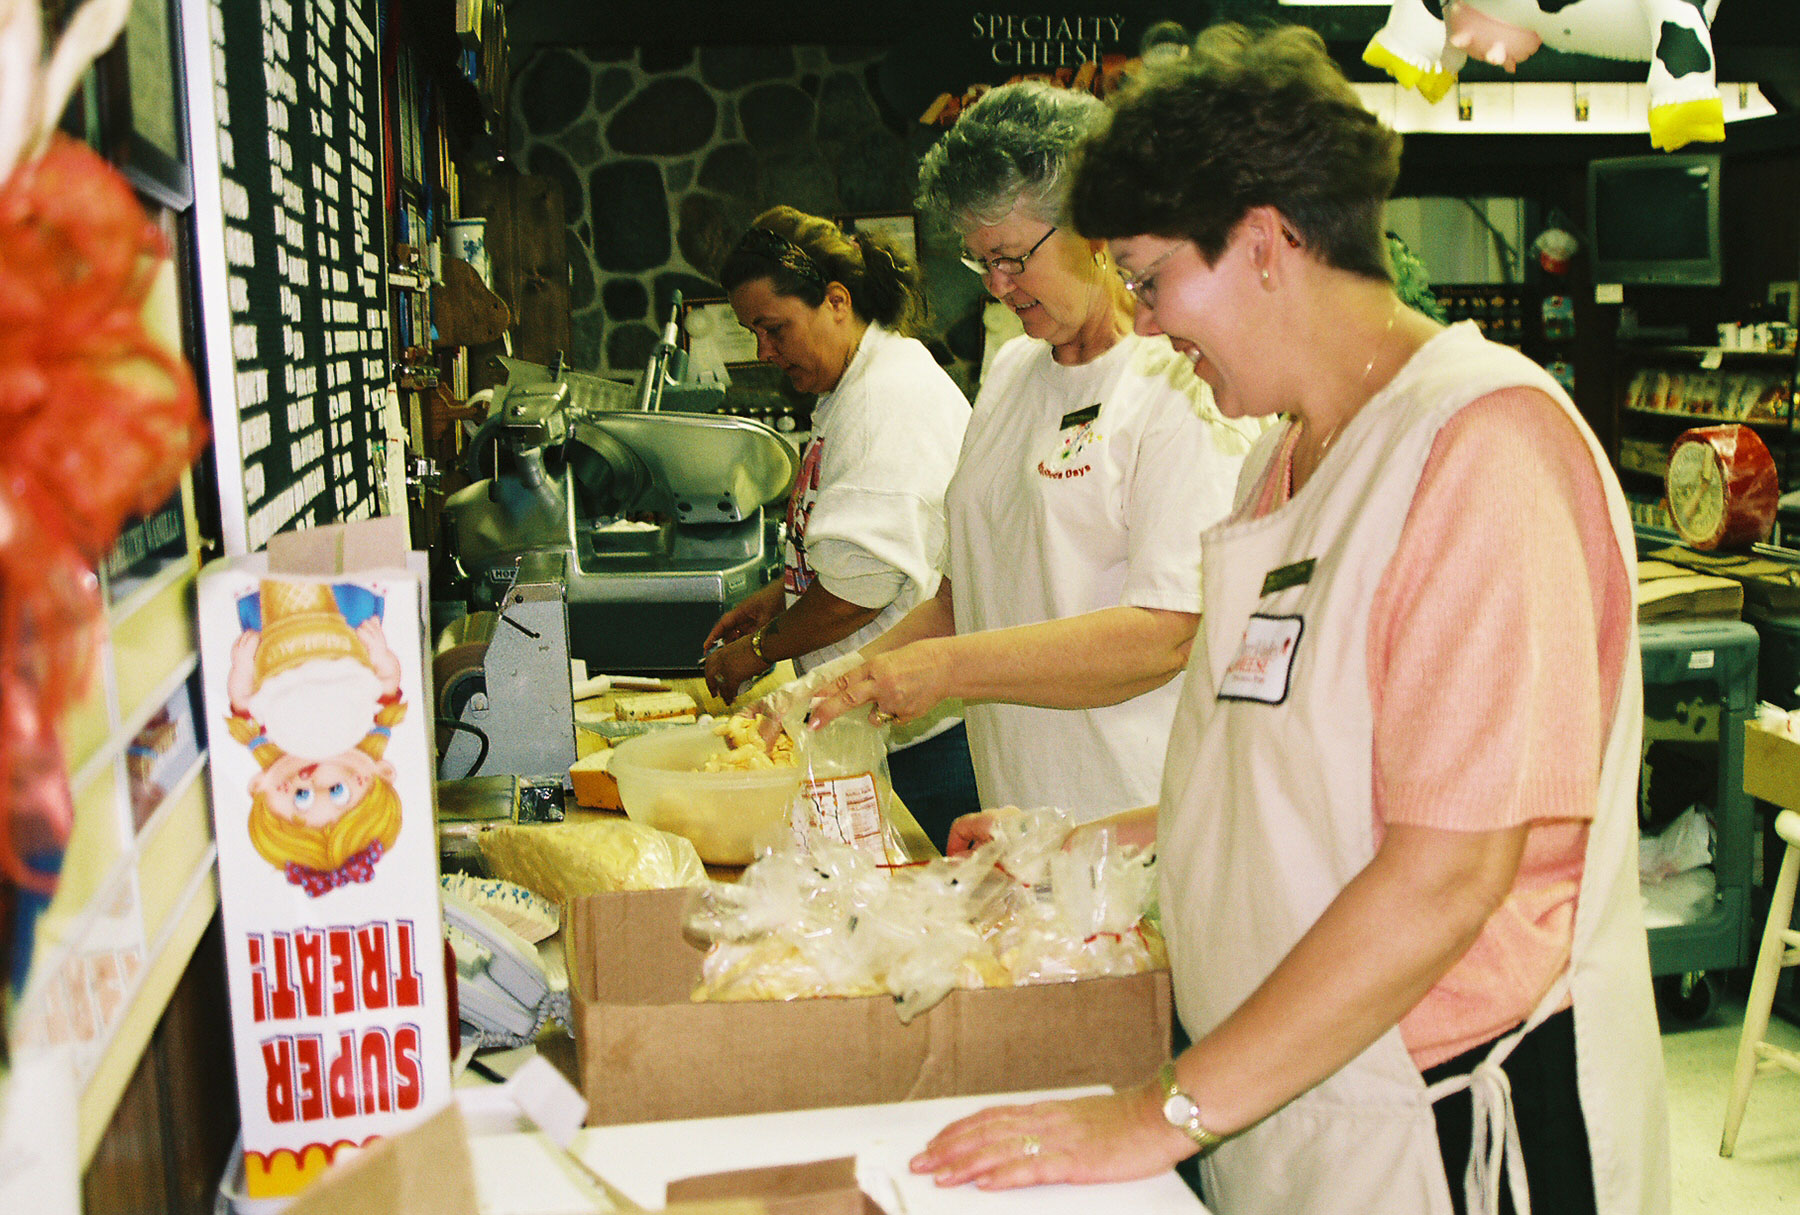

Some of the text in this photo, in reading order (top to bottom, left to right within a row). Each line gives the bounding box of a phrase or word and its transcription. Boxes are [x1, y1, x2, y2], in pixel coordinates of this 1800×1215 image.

[972, 13, 1126, 41] SPECIALTY
[992, 41, 1102, 66] CHEESE
[246, 919, 425, 1024] TREAT!
[260, 1022, 425, 1124] SUPER
